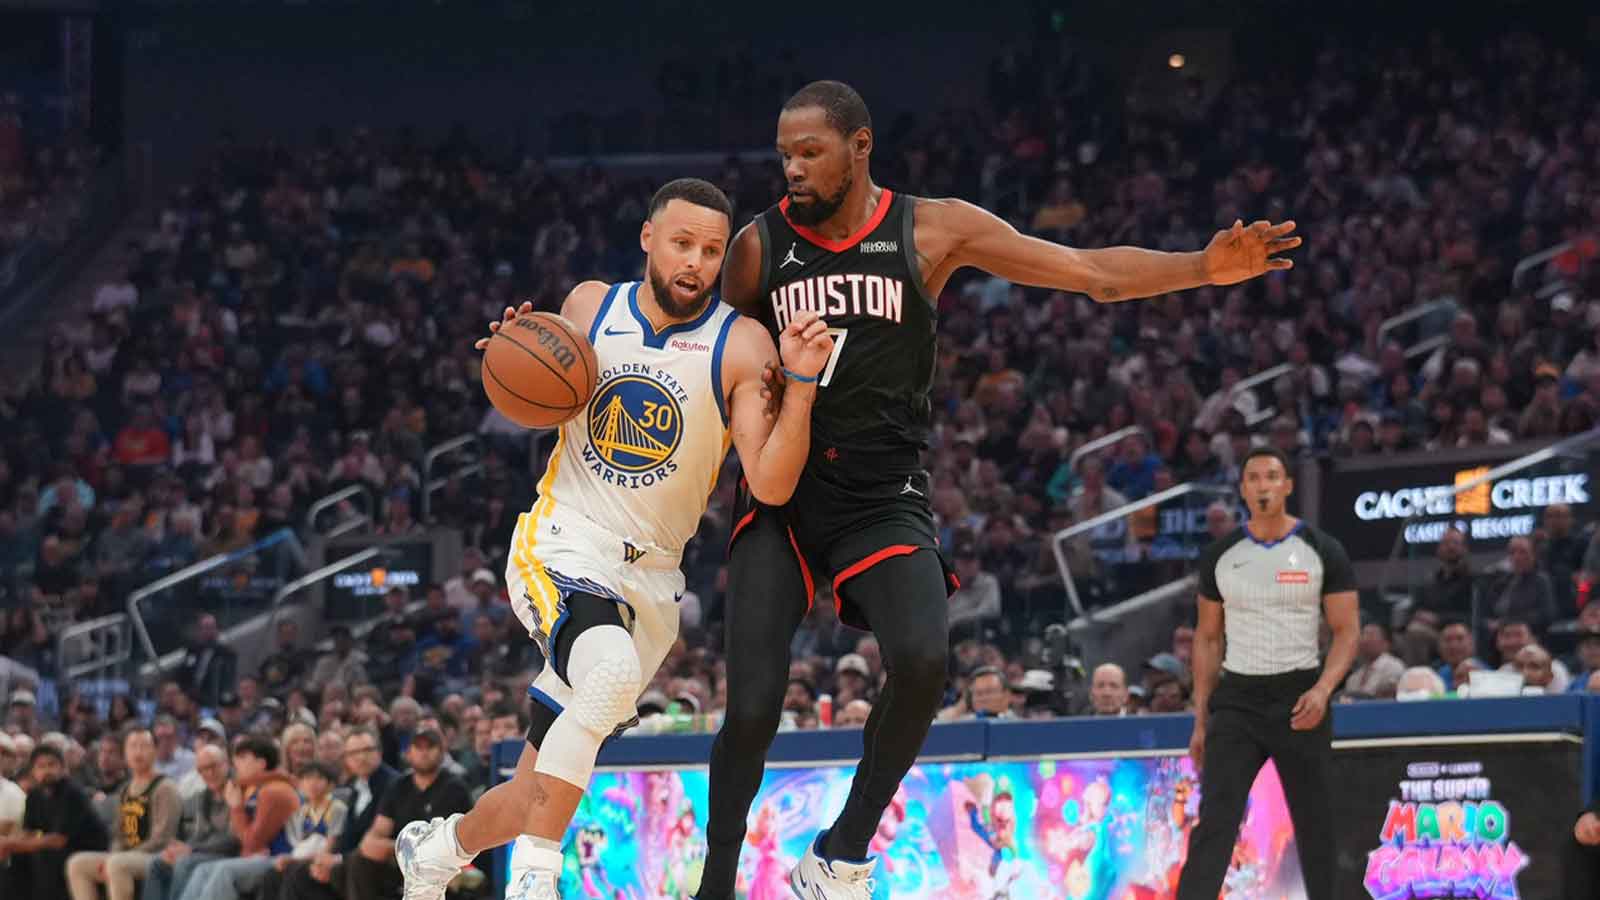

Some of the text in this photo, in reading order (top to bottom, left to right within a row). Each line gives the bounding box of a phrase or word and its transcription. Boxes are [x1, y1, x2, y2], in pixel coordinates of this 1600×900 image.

[770, 273, 903, 334] HOUSTON
[515, 318, 577, 370] Wilson
[671, 339, 711, 353] Rakuten
[818, 327, 849, 388] 7
[655, 369, 689, 405] STATE
[638, 399, 673, 432] 30
[581, 442, 679, 489] WARRIORS
[1491, 473, 1589, 510] CREEK
[1471, 514, 1535, 540] RESORT
[1399, 777, 1491, 801] THE SUPER
[1379, 799, 1509, 846] MARIO
[1363, 842, 1530, 900] GALAXY
